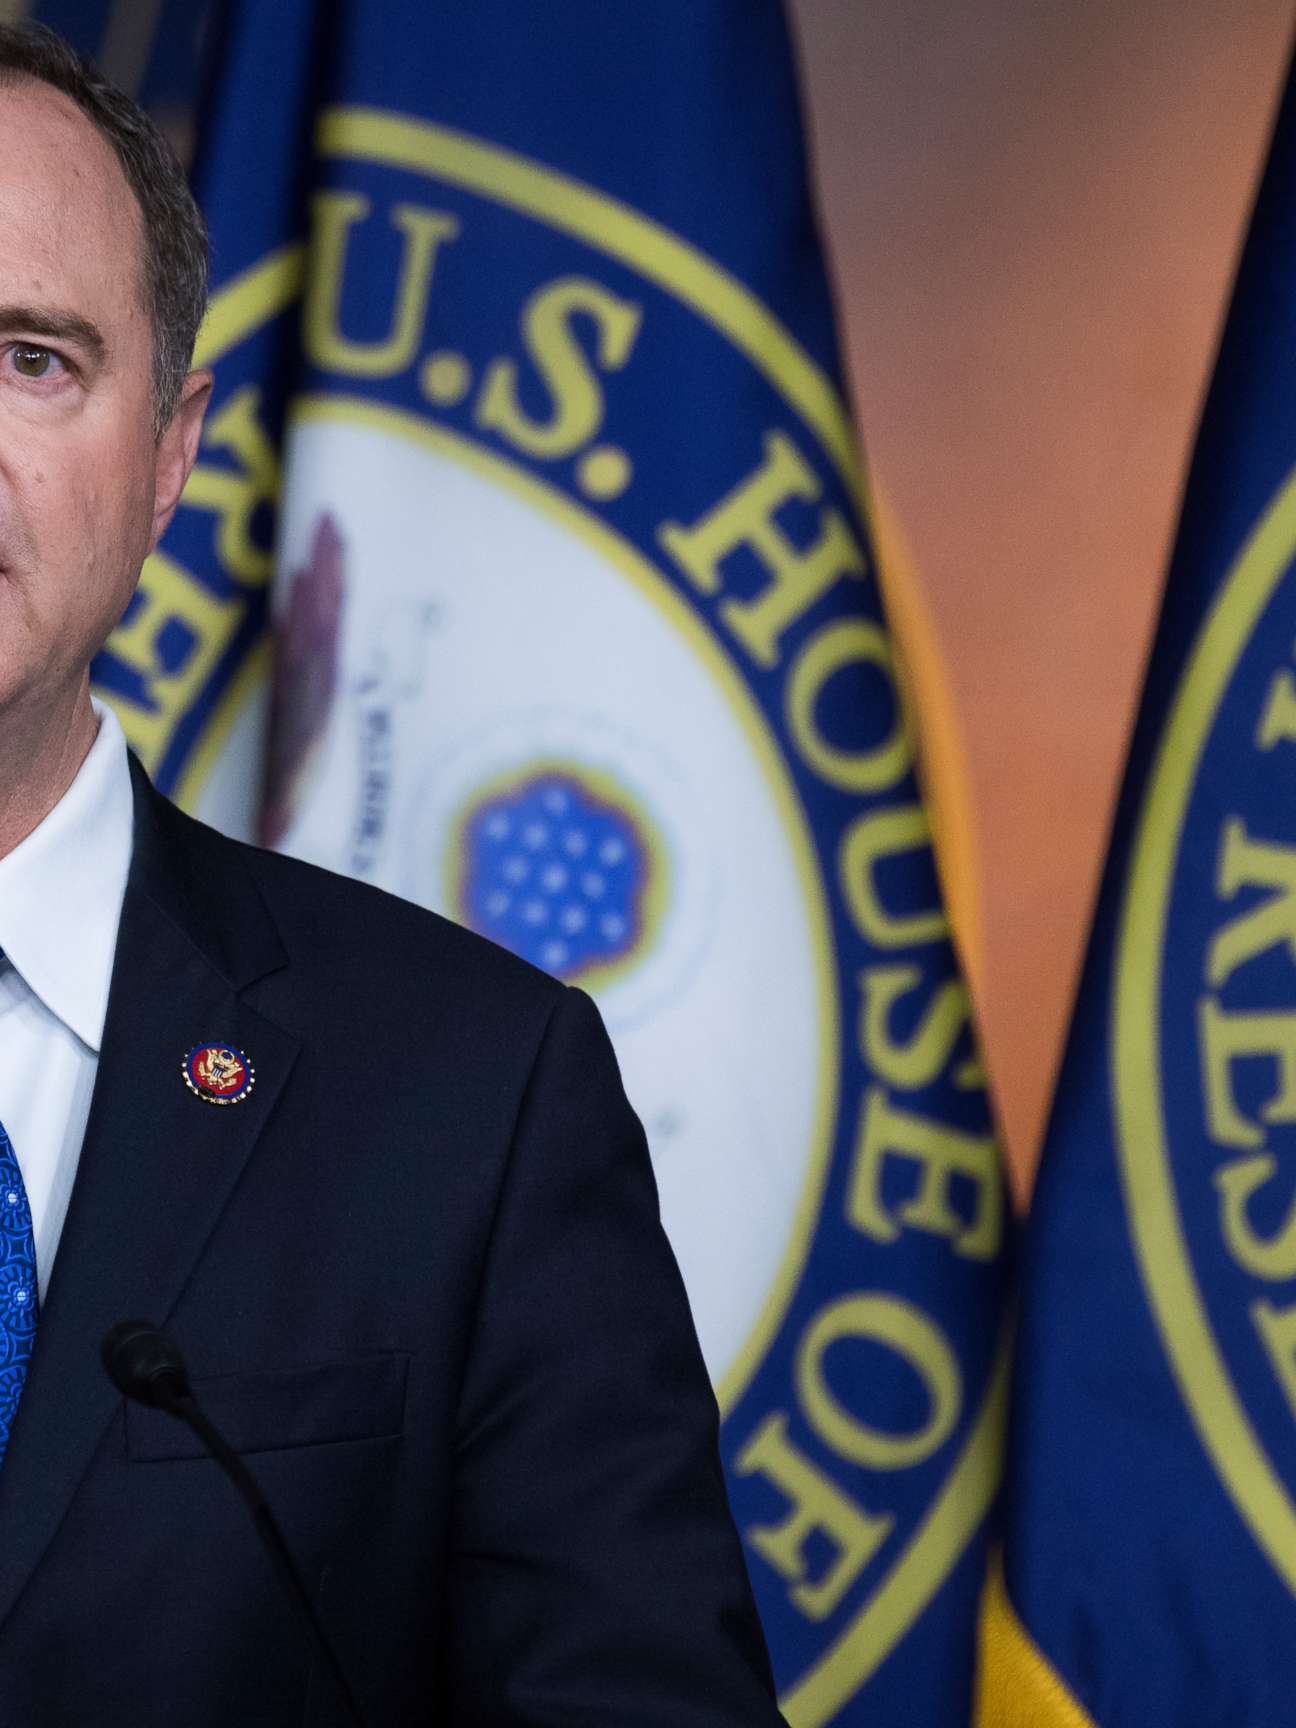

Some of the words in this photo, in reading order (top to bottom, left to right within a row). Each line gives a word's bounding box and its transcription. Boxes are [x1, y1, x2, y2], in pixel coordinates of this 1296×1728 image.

[306, 193, 642, 500] U.S.
[657, 430, 1001, 1261] HOUSE
[735, 1291, 963, 1622] OF
